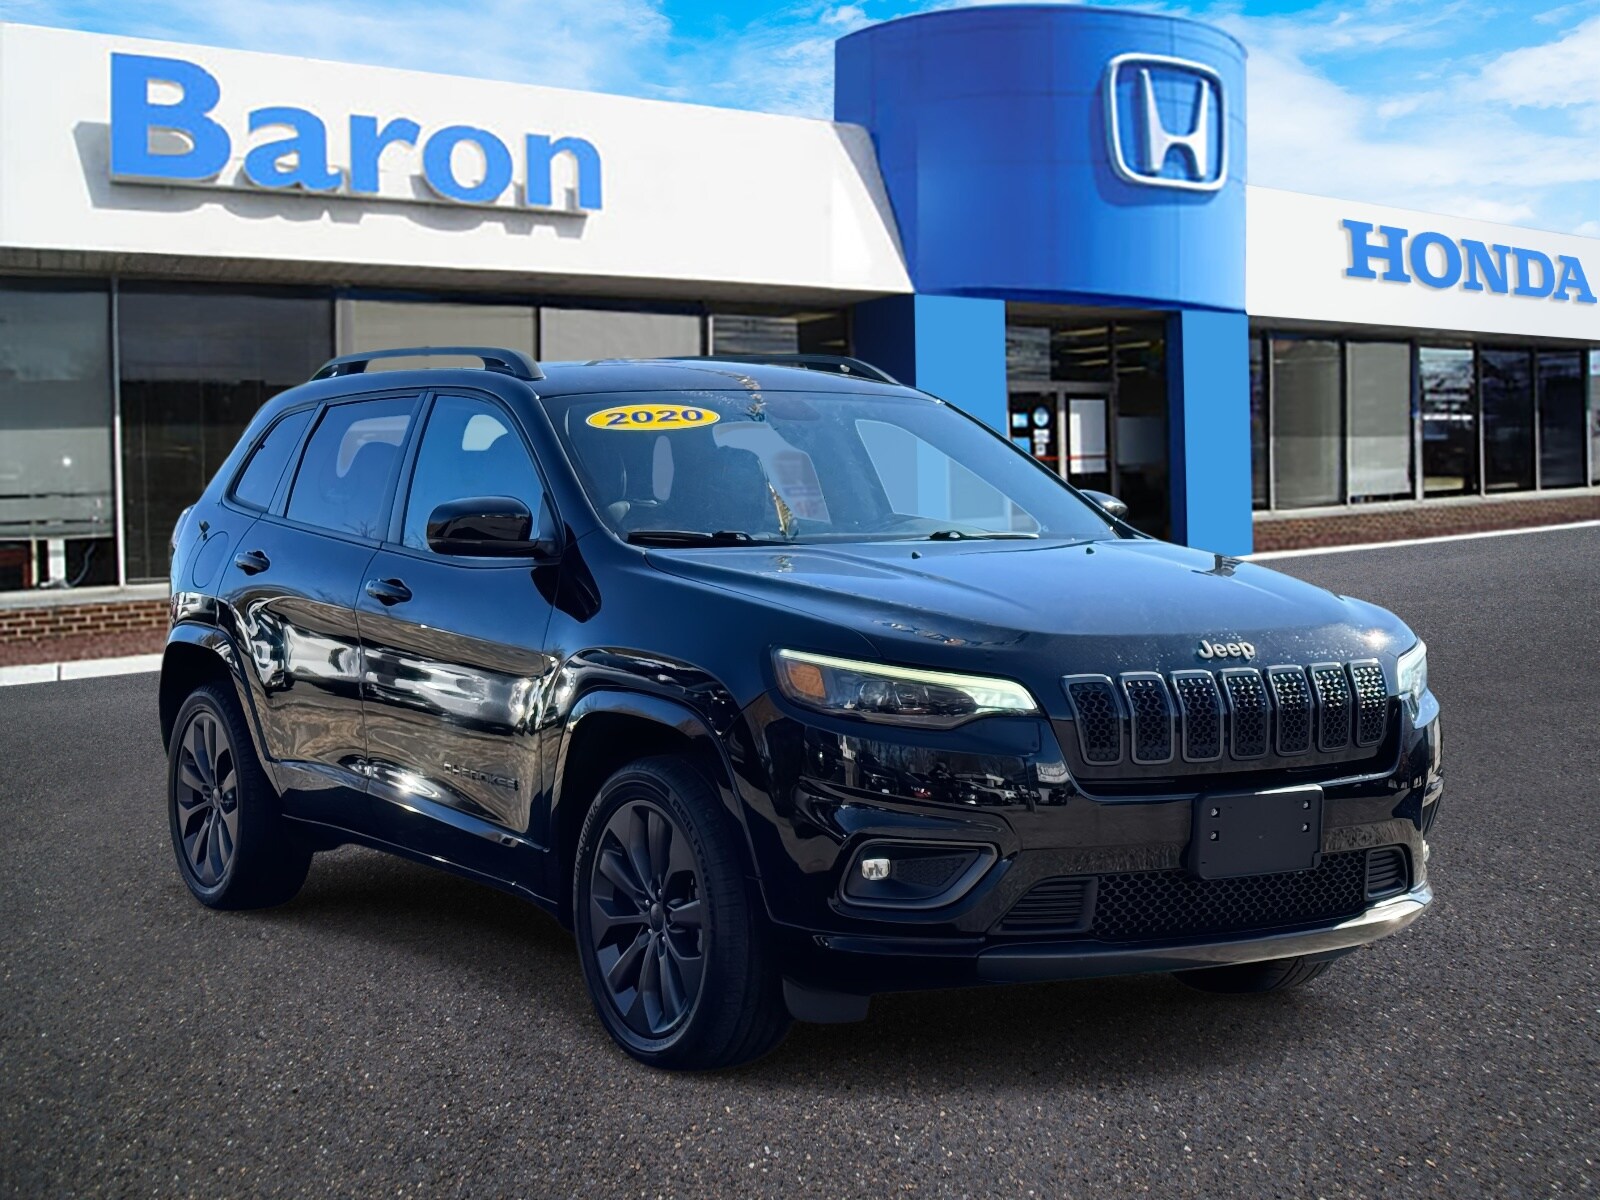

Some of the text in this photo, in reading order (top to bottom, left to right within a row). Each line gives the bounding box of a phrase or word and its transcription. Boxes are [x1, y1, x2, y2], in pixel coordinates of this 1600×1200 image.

[110, 52, 602, 211] Baron
[1342, 218, 1597, 304] HONDA
[605, 409, 704, 426] 2020
[1198, 639, 1256, 661] Jeep
